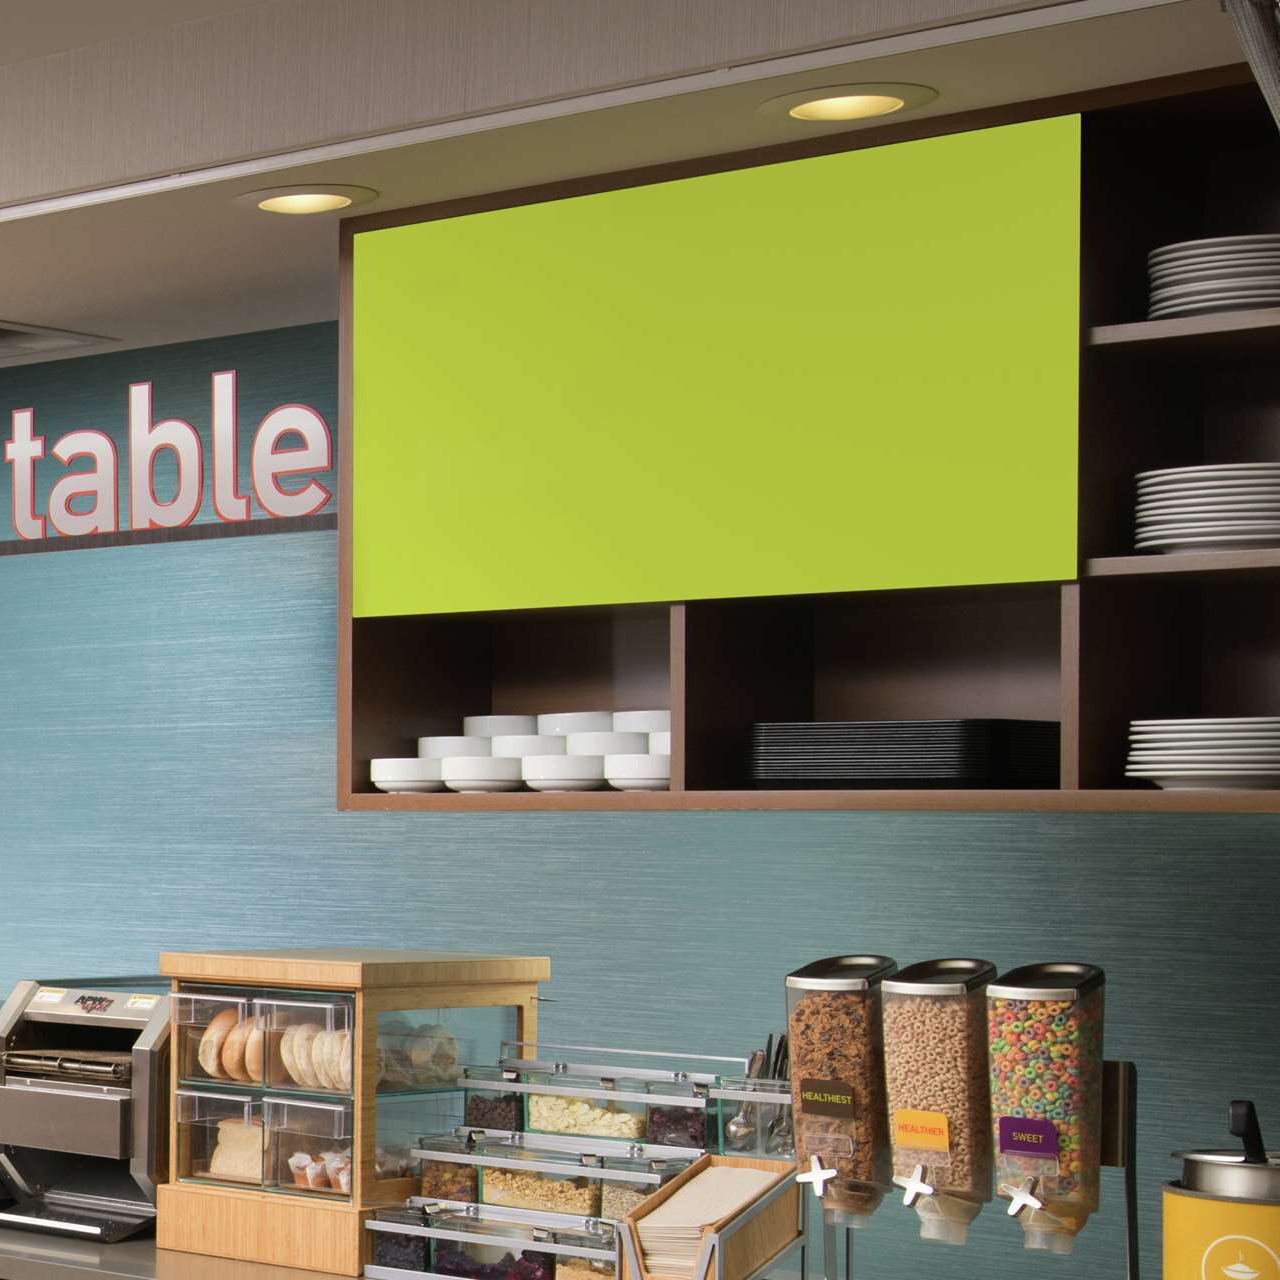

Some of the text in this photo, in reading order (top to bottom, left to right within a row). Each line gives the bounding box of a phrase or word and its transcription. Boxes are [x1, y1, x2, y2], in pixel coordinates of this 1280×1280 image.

[4, 368, 333, 541] table
[802, 1090, 852, 1105] HEALTHIEST
[898, 1124, 945, 1137] HEALTHIER
[1012, 1132, 1043, 1144] SWEET
